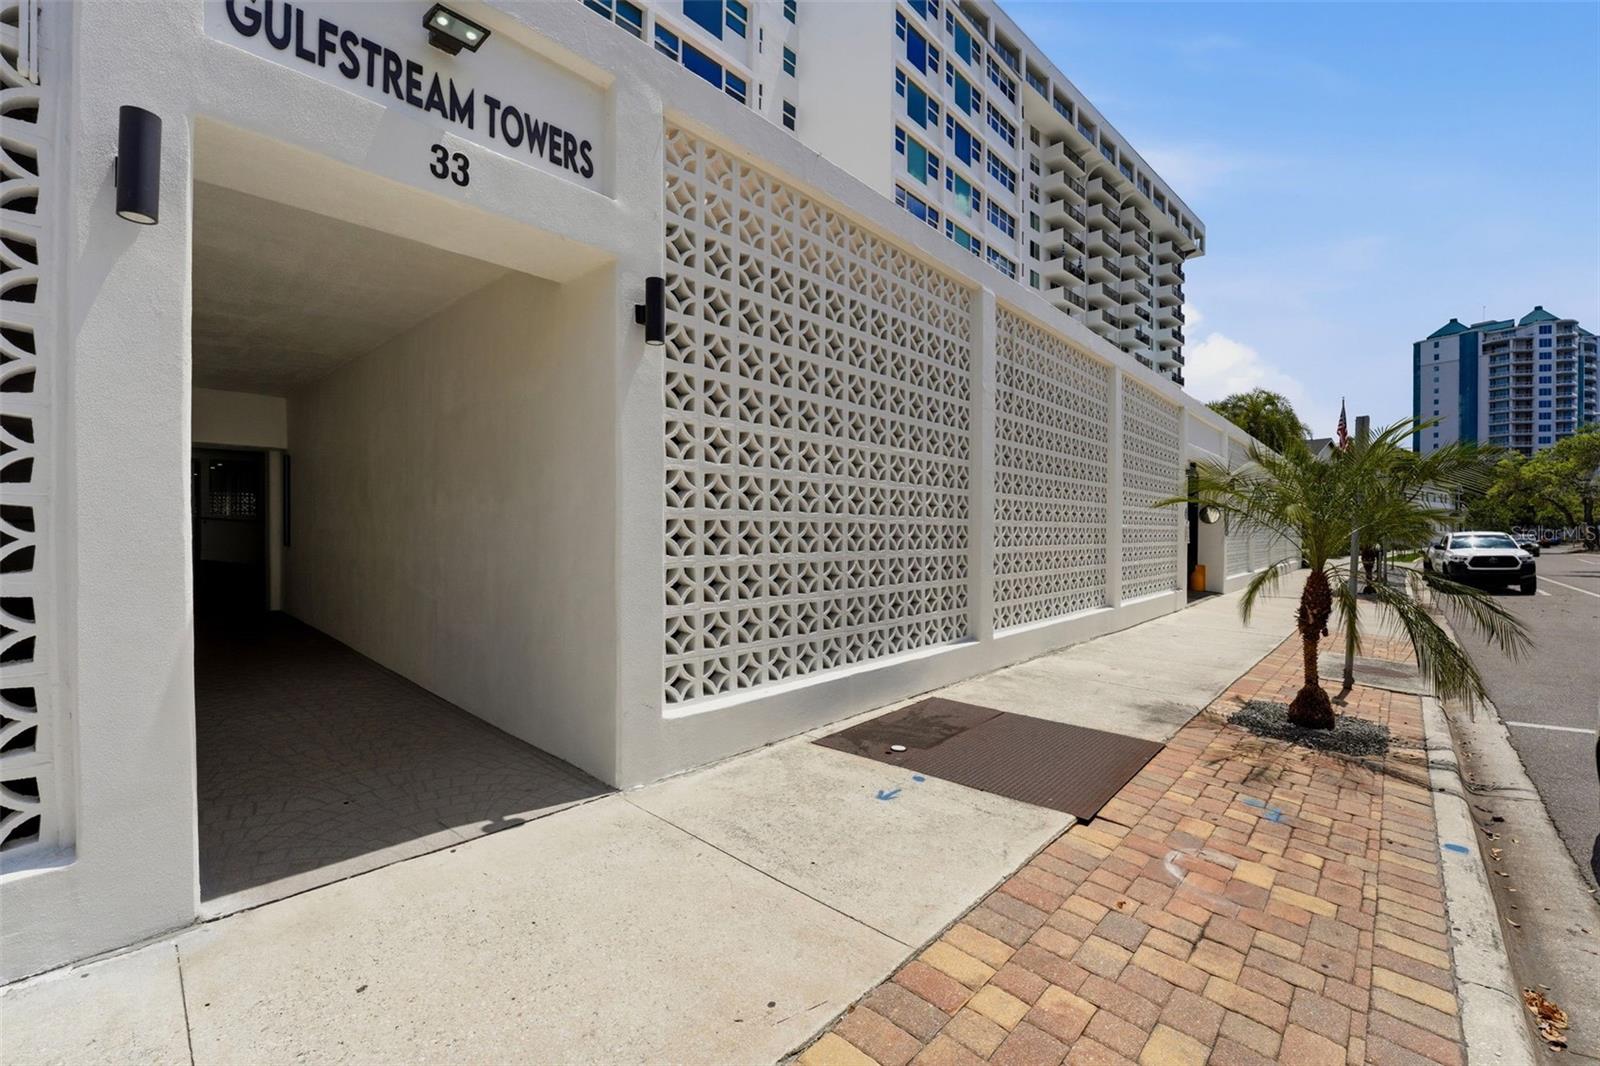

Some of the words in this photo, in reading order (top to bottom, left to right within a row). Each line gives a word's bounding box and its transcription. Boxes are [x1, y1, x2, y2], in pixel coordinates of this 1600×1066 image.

[226, 0, 475, 130] GULFSTREAM
[484, 95, 594, 179] TOWERS
[430, 144, 470, 187] 33
